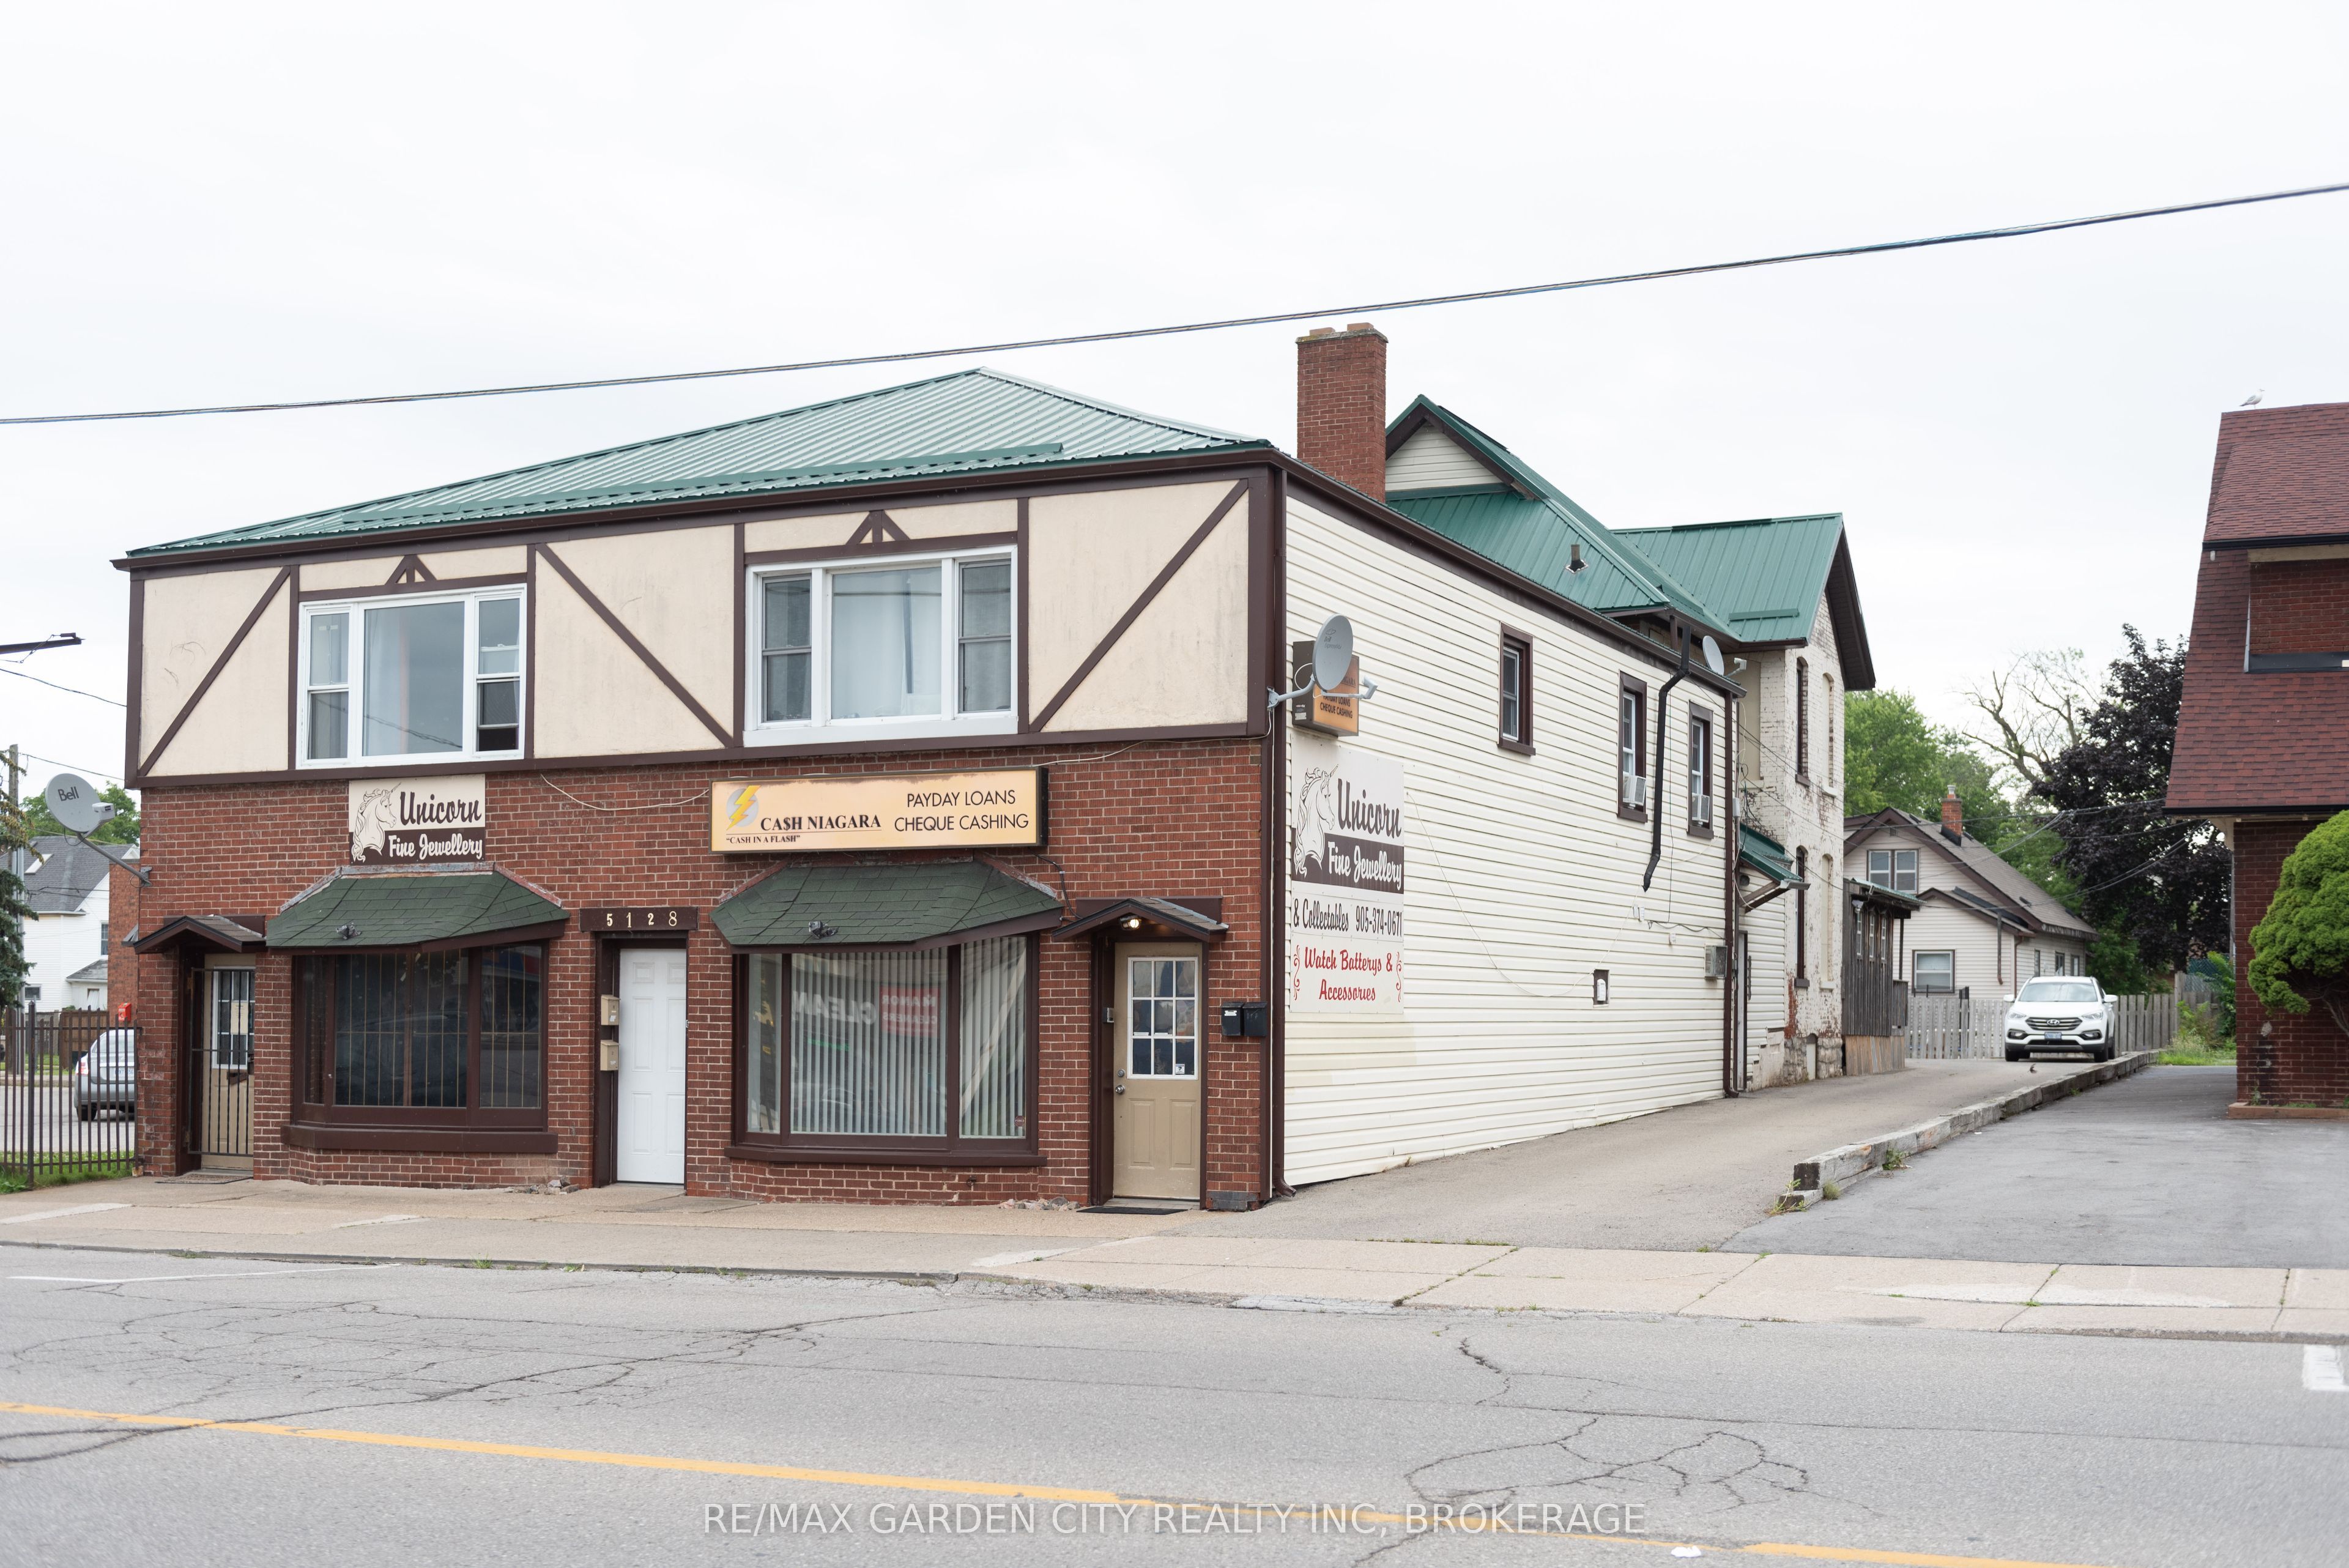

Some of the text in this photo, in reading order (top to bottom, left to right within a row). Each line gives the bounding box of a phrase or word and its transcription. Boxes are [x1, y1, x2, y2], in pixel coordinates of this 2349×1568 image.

[1320, 702, 1353, 718] CHEQUE CASHING
[1338, 697, 1351, 707] LOANS
[58, 786, 80, 801] Bell
[907, 790, 1016, 808] PAYDAY LOANS
[400, 791, 482, 826] Unicorn
[1338, 778, 1402, 839] Unicorn
[760, 814, 881, 831] CA$H NIAGARA
[894, 813, 1030, 832] CHEQUE CASHING
[388, 833, 483, 860] Fine Jewellery
[1327, 841, 1402, 891] Fine Jewellery
[606, 910, 677, 928] 5128
[1293, 898, 1402, 937] & Collectables 905-374-0671
[1304, 946, 1393, 976] Watch Batterys &
[1319, 979, 1376, 1001] Accessories
